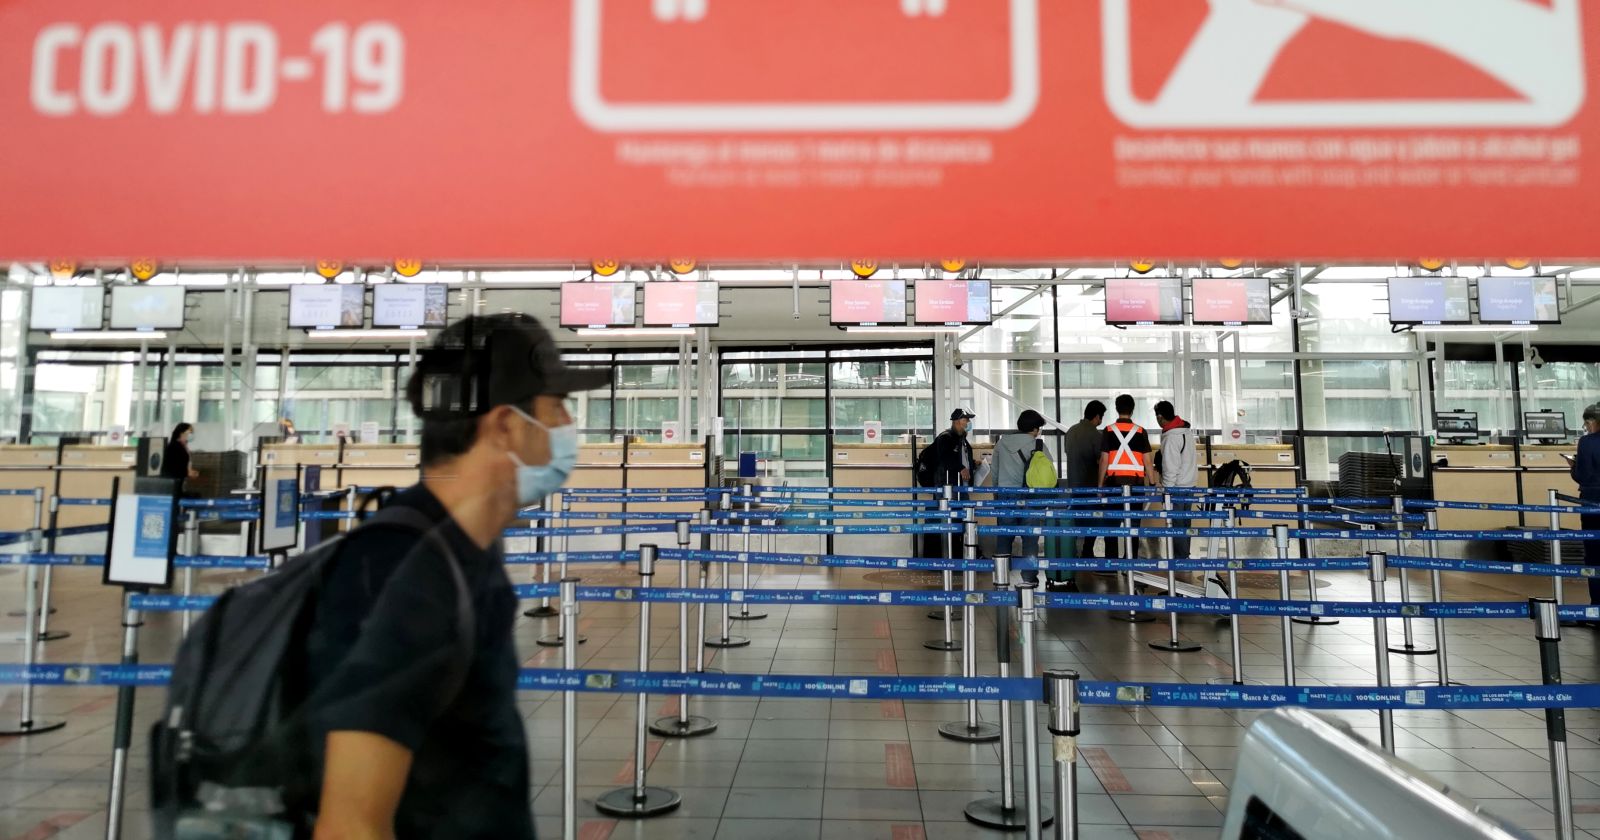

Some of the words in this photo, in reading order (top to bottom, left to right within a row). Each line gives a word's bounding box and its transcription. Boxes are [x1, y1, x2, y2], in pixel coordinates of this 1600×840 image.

[31, 22, 404, 116] COVID-19
[778, 682, 800, 690] FAN
[893, 684, 916, 692] FAN
[958, 685, 976, 693] Banco
[977, 685, 983, 693] de
[985, 685, 999, 693] Chile
[1095, 690, 1110, 698] Chile
[1173, 692, 1197, 700] FAN
[1242, 693, 1260, 701] Banco
[1262, 693, 1268, 701] de
[1270, 693, 1286, 701] Chile
[1327, 694, 1351, 702] FAN
[1526, 694, 1545, 702] Banco
[1547, 694, 1554, 702] de
[1556, 694, 1572, 702] Chile
